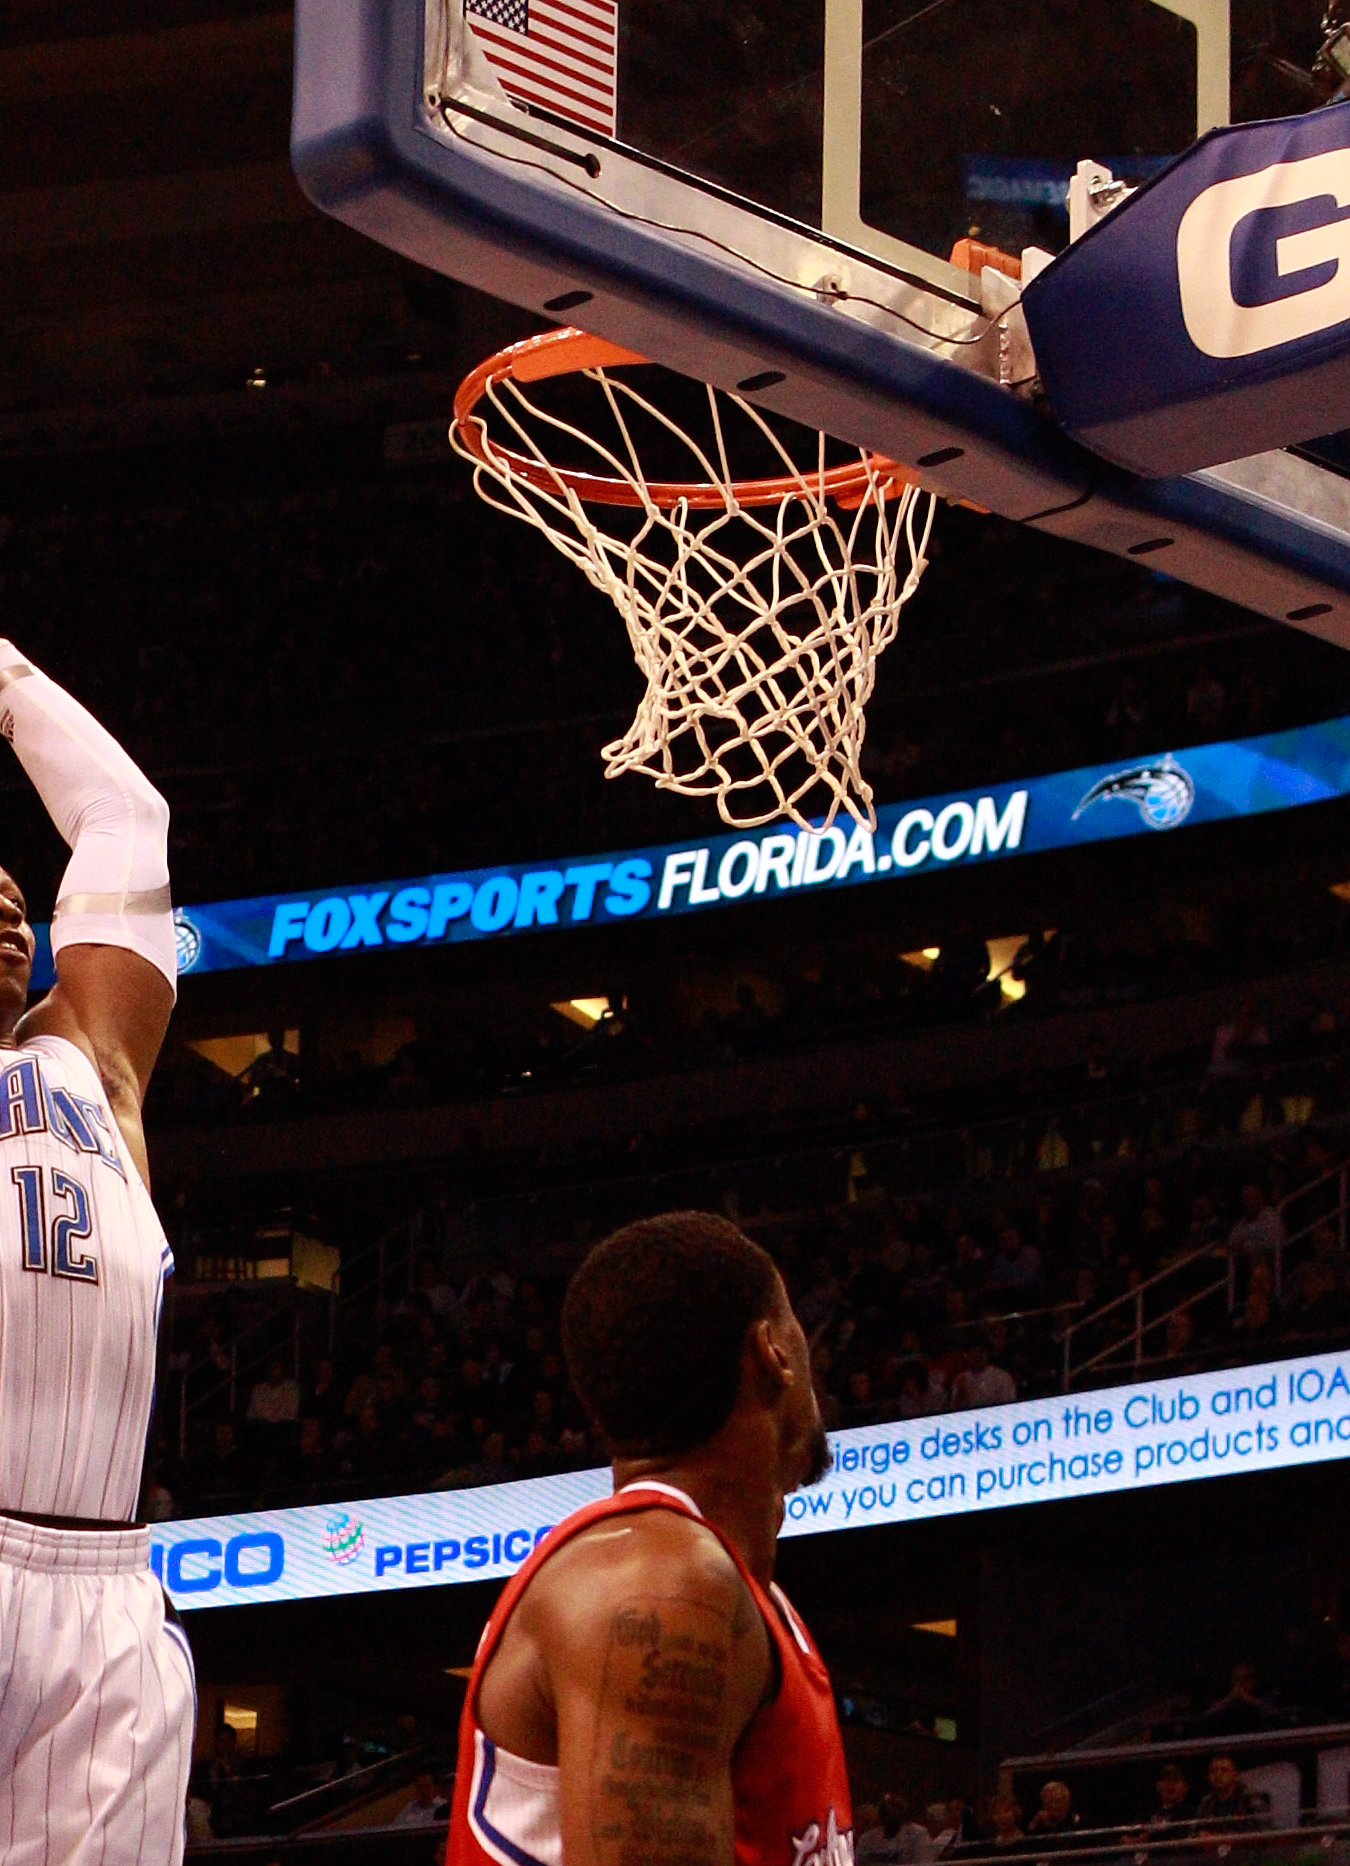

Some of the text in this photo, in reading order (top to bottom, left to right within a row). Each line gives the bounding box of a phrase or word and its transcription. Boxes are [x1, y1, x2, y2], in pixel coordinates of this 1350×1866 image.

[1177, 148, 1350, 358] G
[11, 1165, 99, 1286] 12
[830, 1366, 1350, 1474] ierge desks on the Club and IOA
[841, 1483, 896, 1518] you
[906, 1473, 966, 1503] can
[976, 1450, 1123, 1500] purchase
[1135, 1419, 1279, 1478] products
